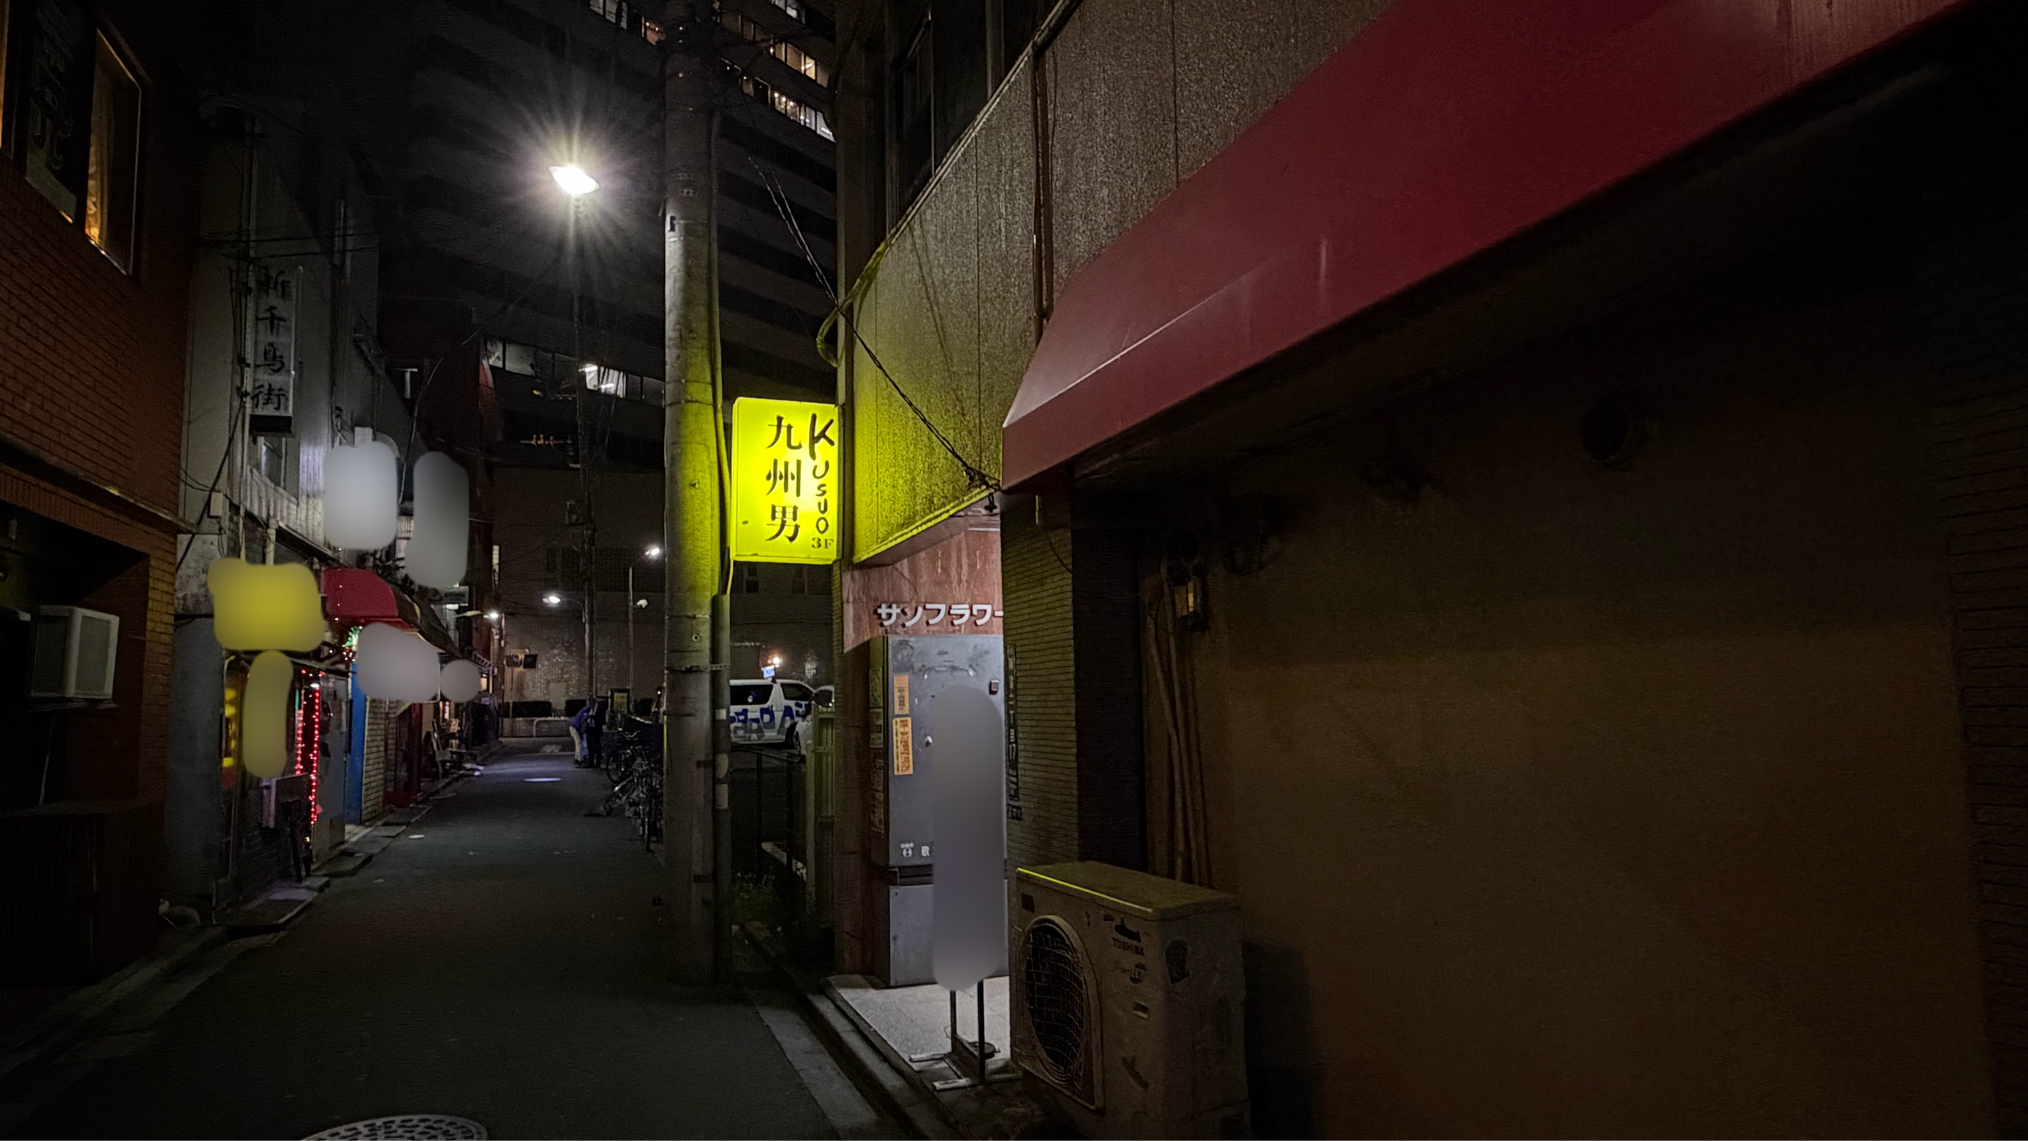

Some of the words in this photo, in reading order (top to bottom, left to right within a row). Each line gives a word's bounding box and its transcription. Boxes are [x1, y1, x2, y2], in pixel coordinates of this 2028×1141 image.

[765, 414, 803, 543] 九州男
[811, 536, 834, 549] 3F
[1112, 937, 1145, 957] TOSHIBA
